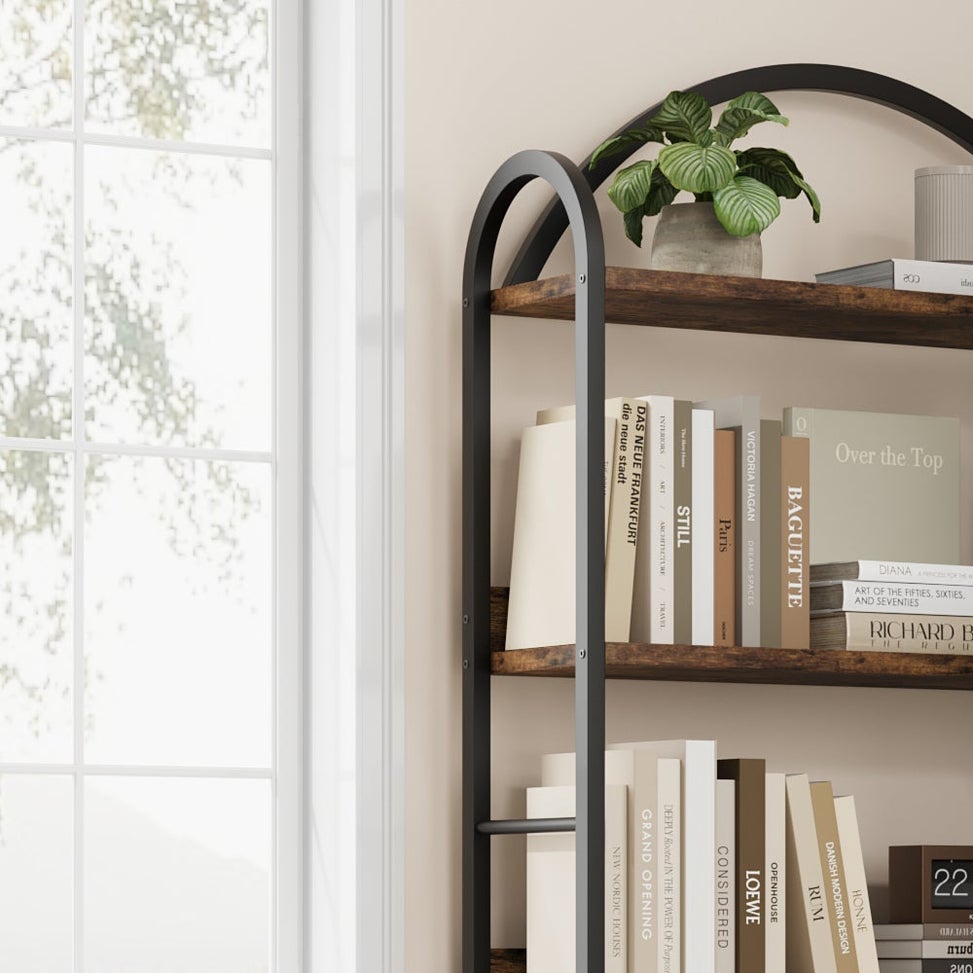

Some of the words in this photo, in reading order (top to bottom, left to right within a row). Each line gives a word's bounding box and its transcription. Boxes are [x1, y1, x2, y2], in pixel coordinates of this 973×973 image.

[621, 403, 632, 421] die
[635, 406, 646, 431] DAS
[619, 424, 629, 452] neue
[632, 435, 644, 469] NEUE
[617, 455, 628, 484] stadt
[746, 431, 756, 482] VICTORIA
[835, 442, 876, 465] Over
[880, 445, 906, 466] the
[911, 447, 943, 475] Top
[627, 472, 642, 547] FRANKFURT
[746, 484, 756, 521] HAGAN
[677, 505, 690, 548] STILL
[719, 519, 732, 553] Paris
[788, 486, 803, 608] BAGUETTE
[880, 565, 913, 576] DIANA
[854, 586, 870, 595] ART
[873, 587, 886, 596] OF
[888, 588, 902, 596] THE
[905, 588, 933, 598] FIFTIES,
[936, 590, 966, 600] SIXTIES,
[854, 596, 874, 605] AND
[876, 597, 920, 607] SEVENTIES
[870, 620, 955, 641] RICHARD
[641, 808, 653, 863] GRAND
[664, 804, 673, 836] DEEPLY
[612, 846, 621, 869] NEW
[664, 837, 673, 865] Rooted
[825, 841, 839, 877] DANISH
[664, 866, 673, 875] IN
[664, 878, 673, 896] THE
[934, 868, 969, 897] 22
[612, 874, 621, 913] NORDIC
[641, 870, 653, 941] OPENING
[717, 845, 729, 949] CONSIDERED
[745, 870, 761, 925] LOEWE
[770, 862, 779, 924] OPENHOUSE
[808, 886, 824, 922] RUM
[832, 879, 845, 919] MODERN
[664, 897, 673, 928] POWER
[612, 918, 621, 958] HOUSES
[664, 930, 673, 943] OF
[838, 921, 850, 955] DESIGN
